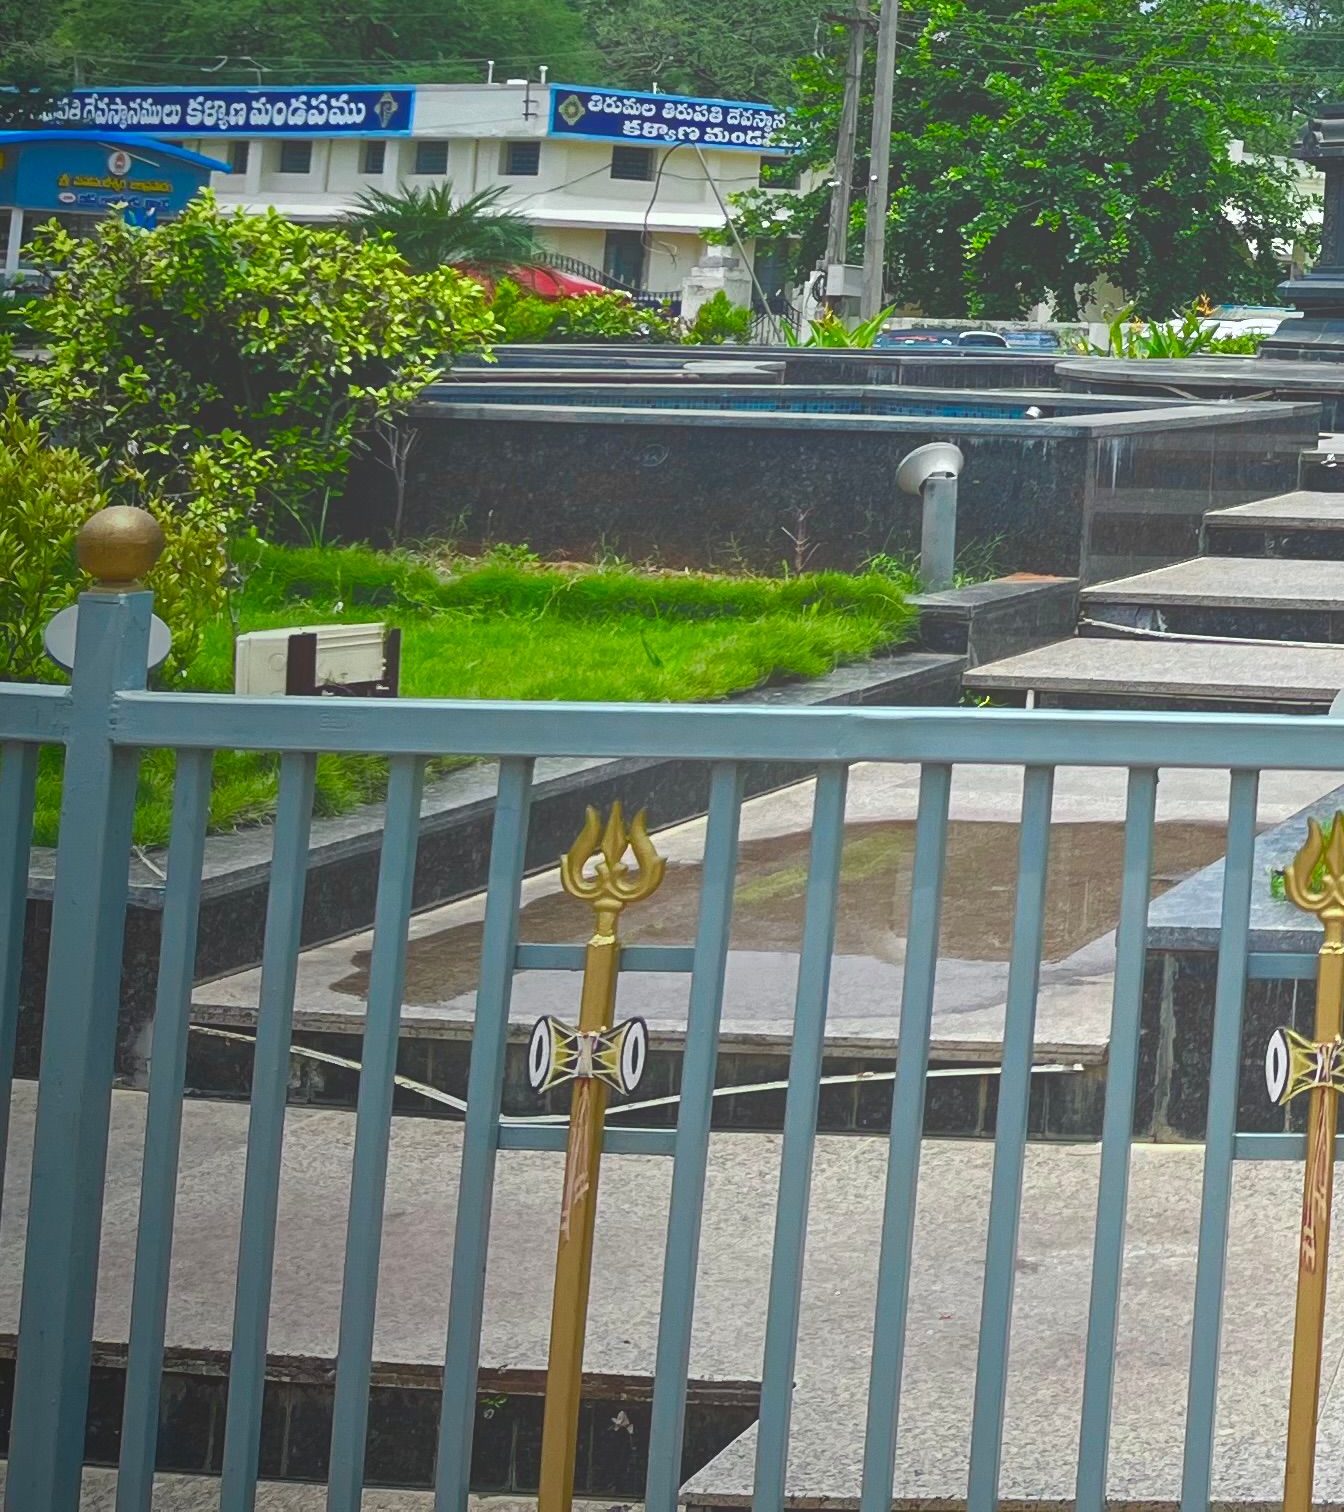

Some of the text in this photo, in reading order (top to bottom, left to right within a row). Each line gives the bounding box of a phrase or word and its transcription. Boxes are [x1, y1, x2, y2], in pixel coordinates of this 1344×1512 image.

[186, 95, 247, 130] కళ్యాణ
[249, 94, 366, 126] మండపము
[587, 95, 656, 116] తిరుమల
[662, 100, 723, 123] తిరుపతి
[622, 119, 700, 141] కళ్యాణ
